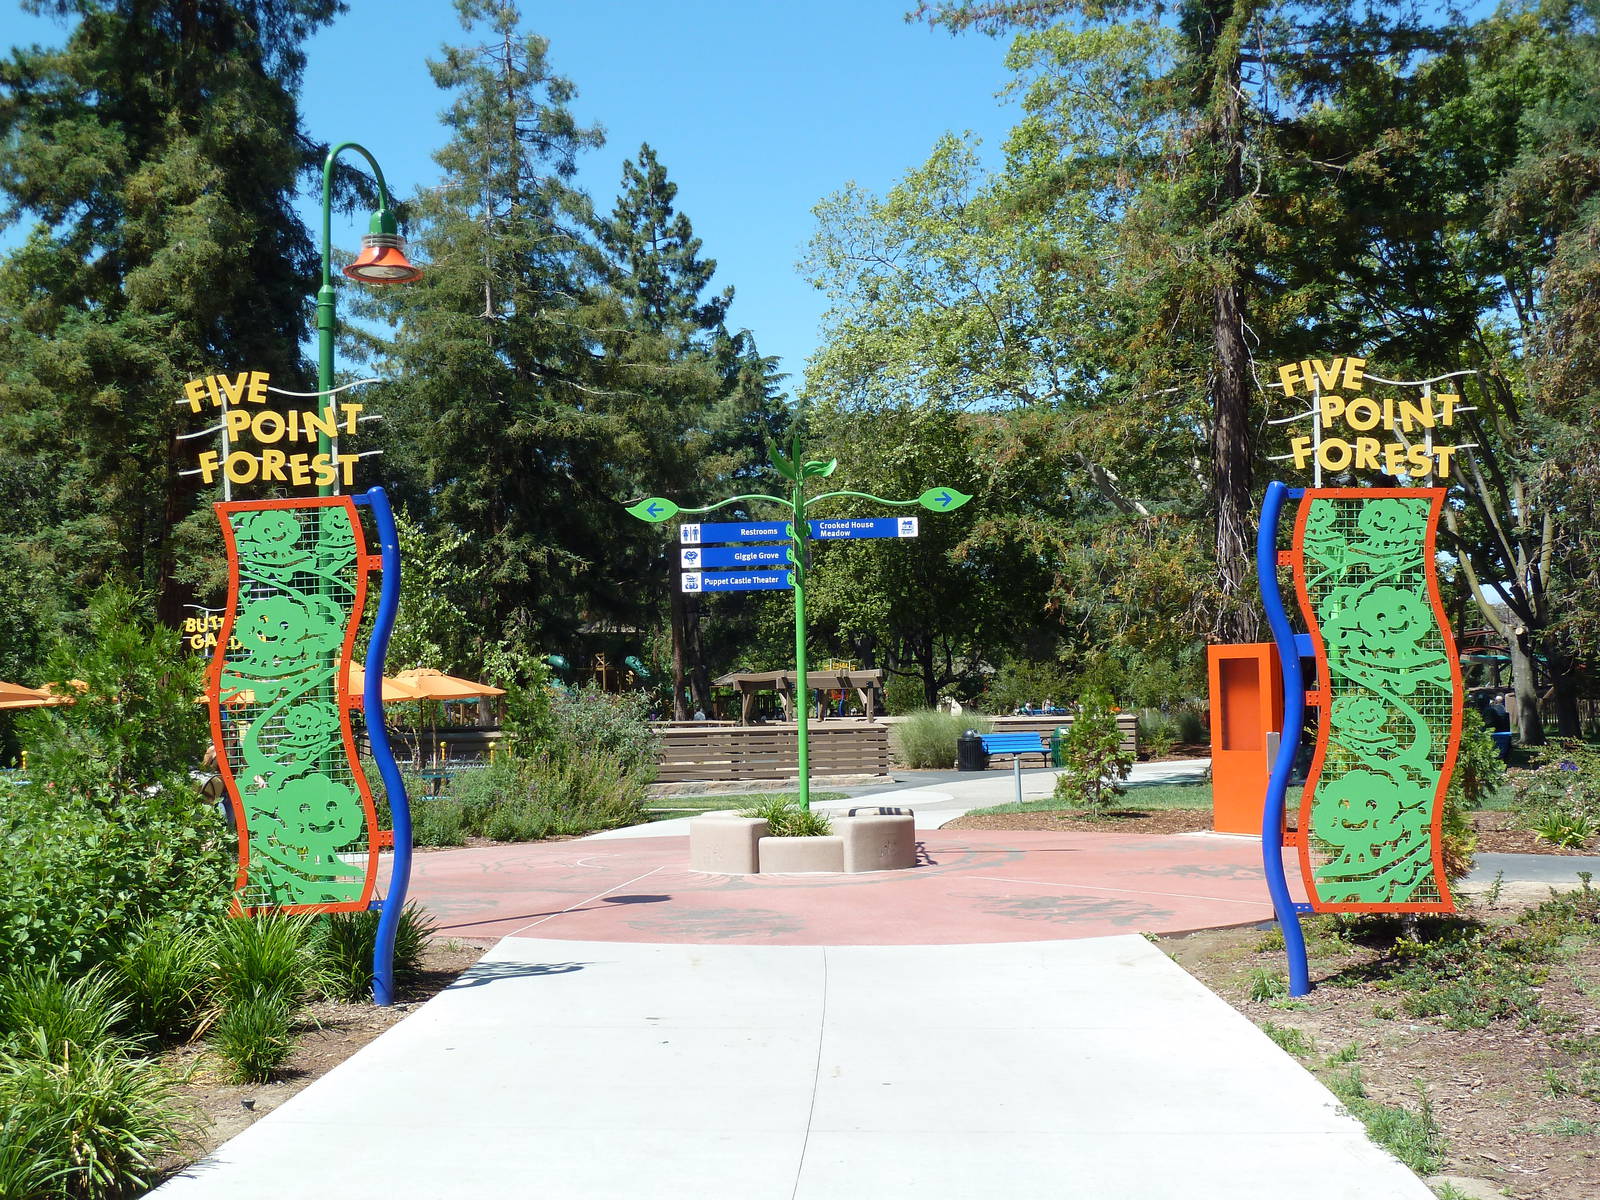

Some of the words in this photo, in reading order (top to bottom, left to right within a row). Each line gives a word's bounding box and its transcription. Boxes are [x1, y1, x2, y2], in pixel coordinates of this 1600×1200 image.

[185, 371, 270, 413] FIVE
[1278, 357, 1366, 397] FIVE
[226, 403, 363, 444] POINT
[1320, 394, 1460, 432] POINT
[199, 449, 359, 486] FOREST
[1291, 436, 1456, 478] FOREST
[740, 528, 778, 536] Restrooms
[820, 521, 850, 530] Crooked
[851, 521, 874, 529] House
[734, 552, 758, 562] Giggle
[758, 551, 780, 560] Grove
[704, 577, 729, 587] Puppet
[730, 576, 753, 585] Castle
[752, 576, 779, 584] Theater
